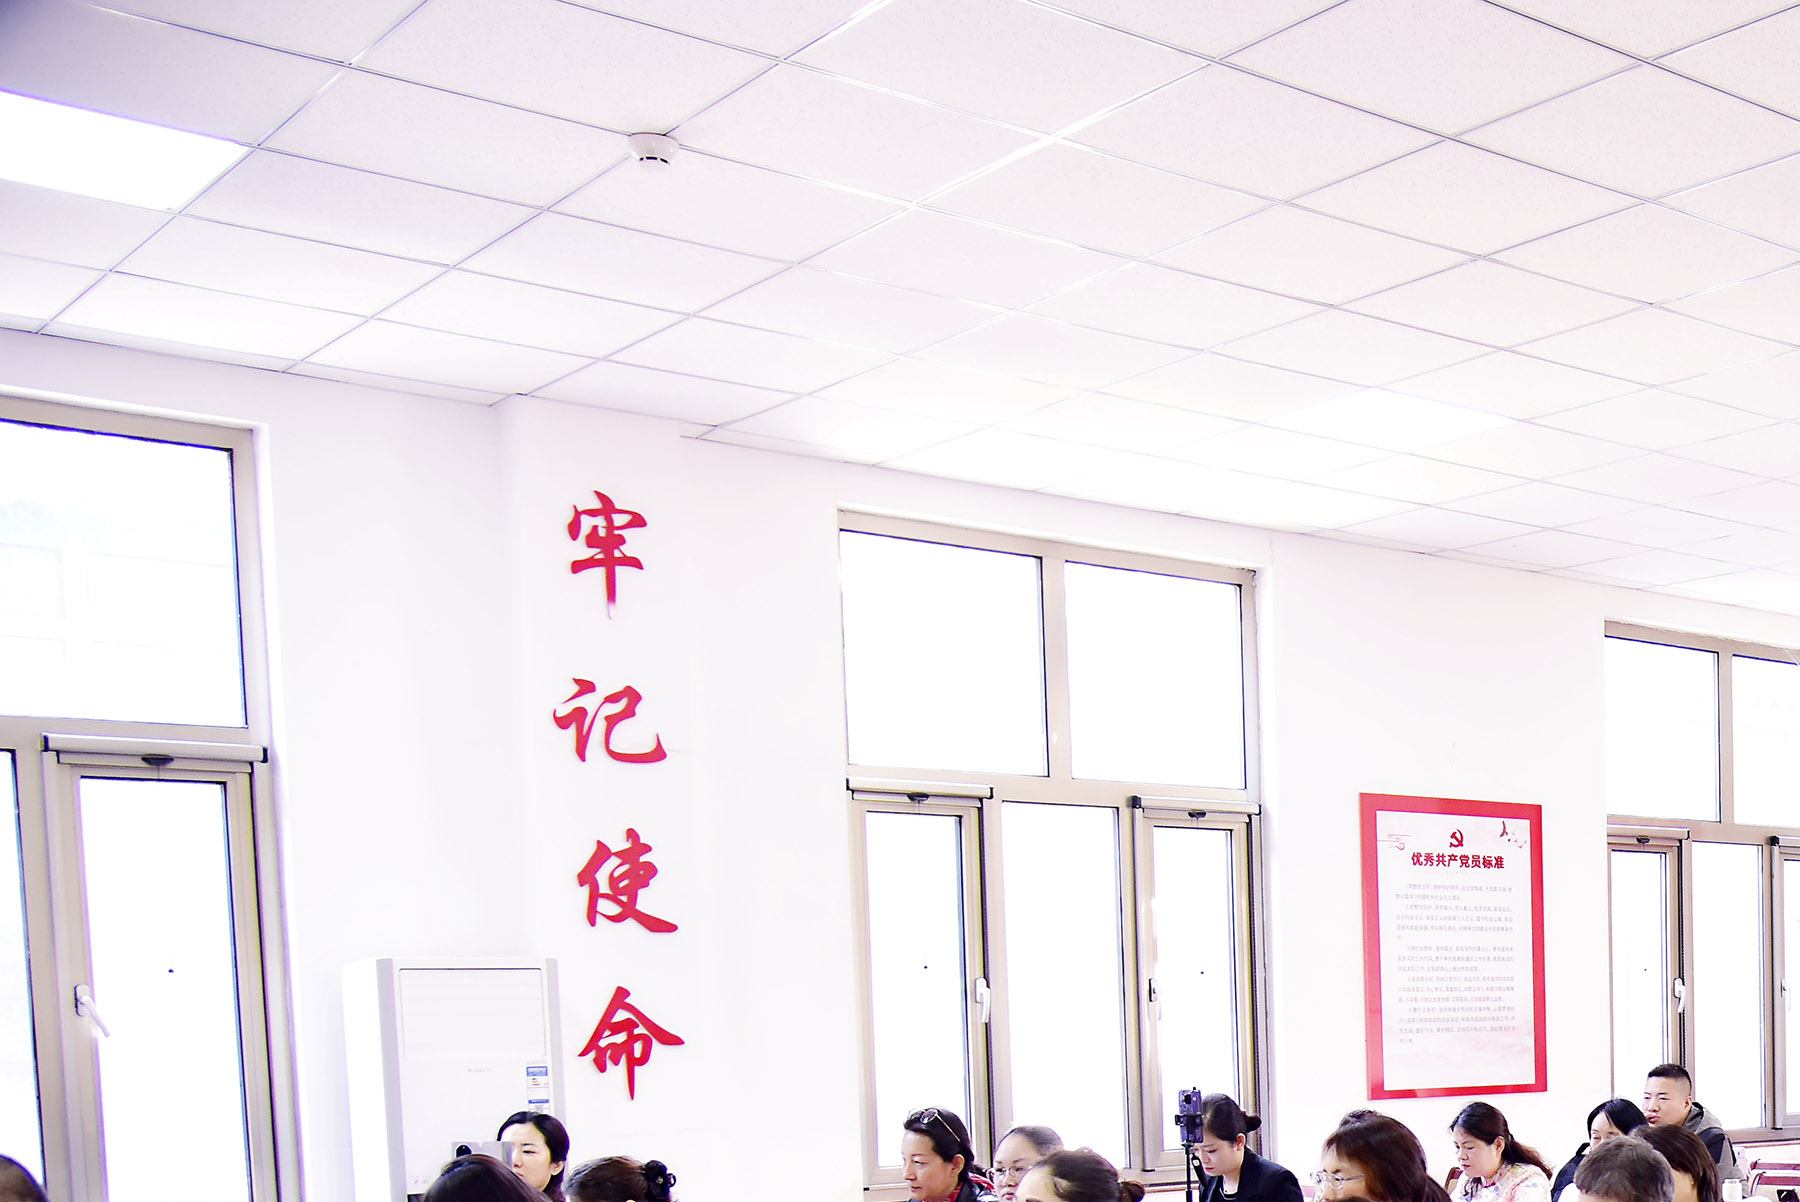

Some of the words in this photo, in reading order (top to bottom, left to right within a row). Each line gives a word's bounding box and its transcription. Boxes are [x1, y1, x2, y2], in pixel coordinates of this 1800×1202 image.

[553, 489, 685, 1101] 牢记使命
[1411, 851, 1504, 869] 优秀共产党员标准
